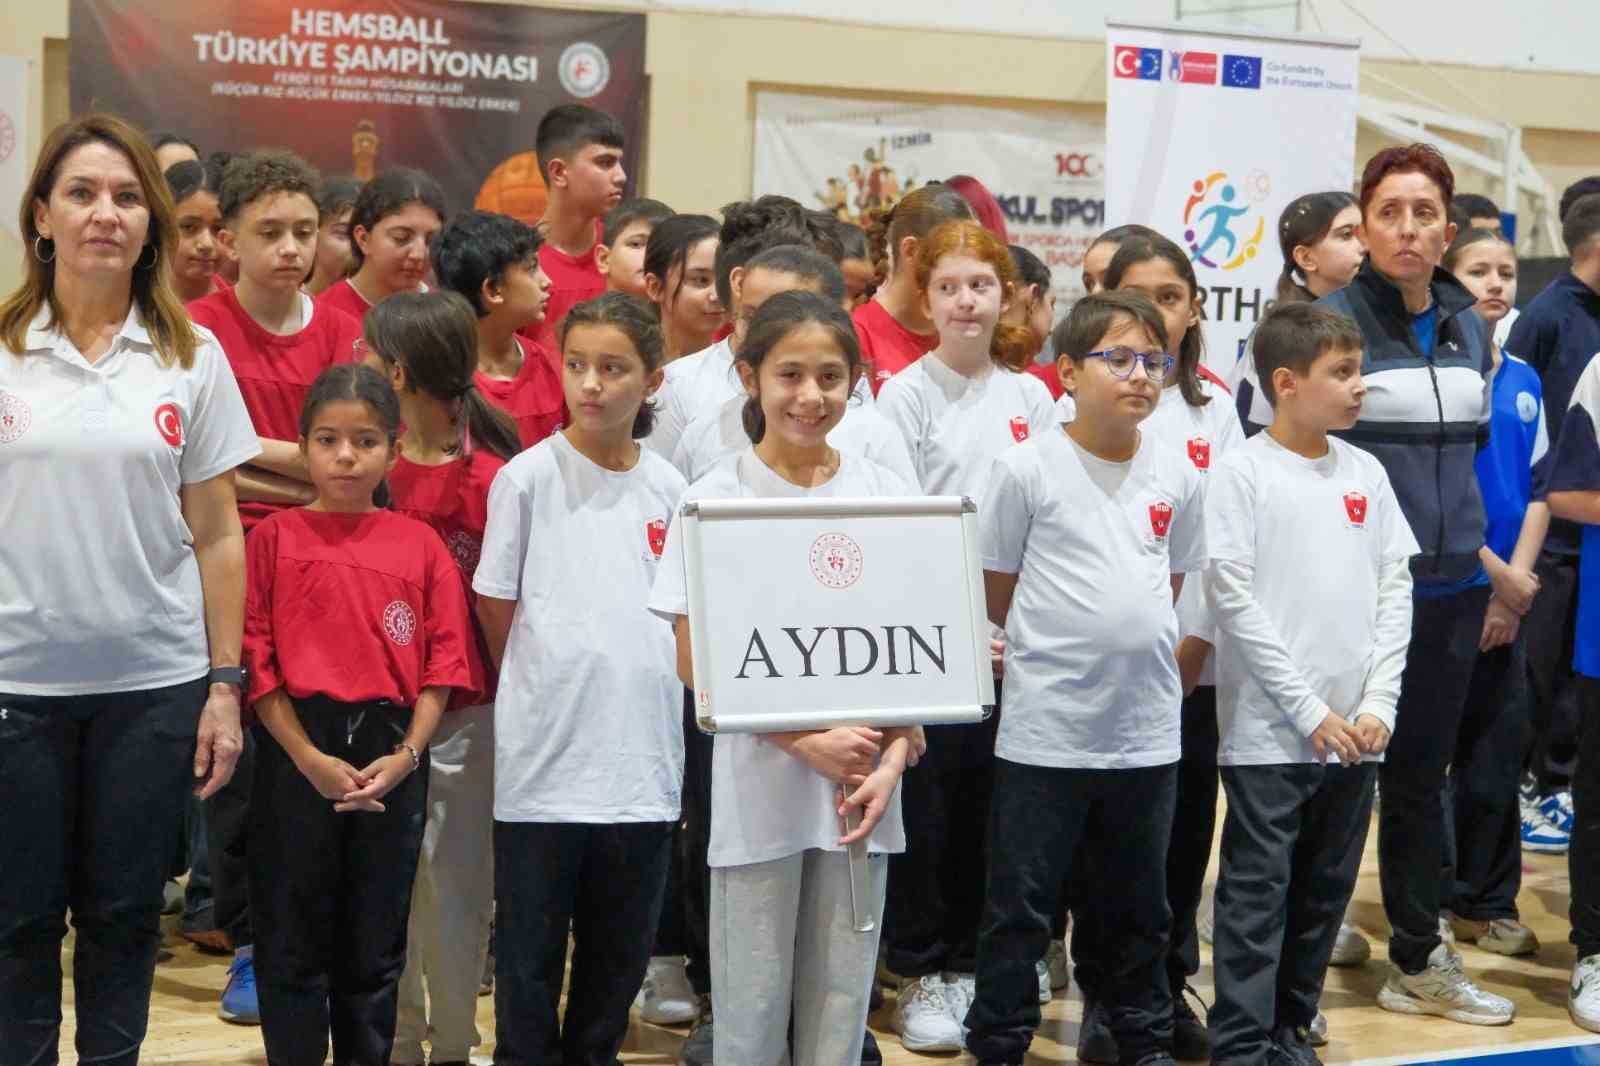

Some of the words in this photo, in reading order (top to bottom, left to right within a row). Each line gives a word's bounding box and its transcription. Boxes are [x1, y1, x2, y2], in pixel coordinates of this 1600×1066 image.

[291, 9, 450, 46] HEMSBALL
[193, 30, 326, 68] TÜRKİYE
[334, 41, 538, 82] ŞAMPİYONASI
[995, 193, 1047, 224] KUL
[734, 625, 948, 679] AYDIN
